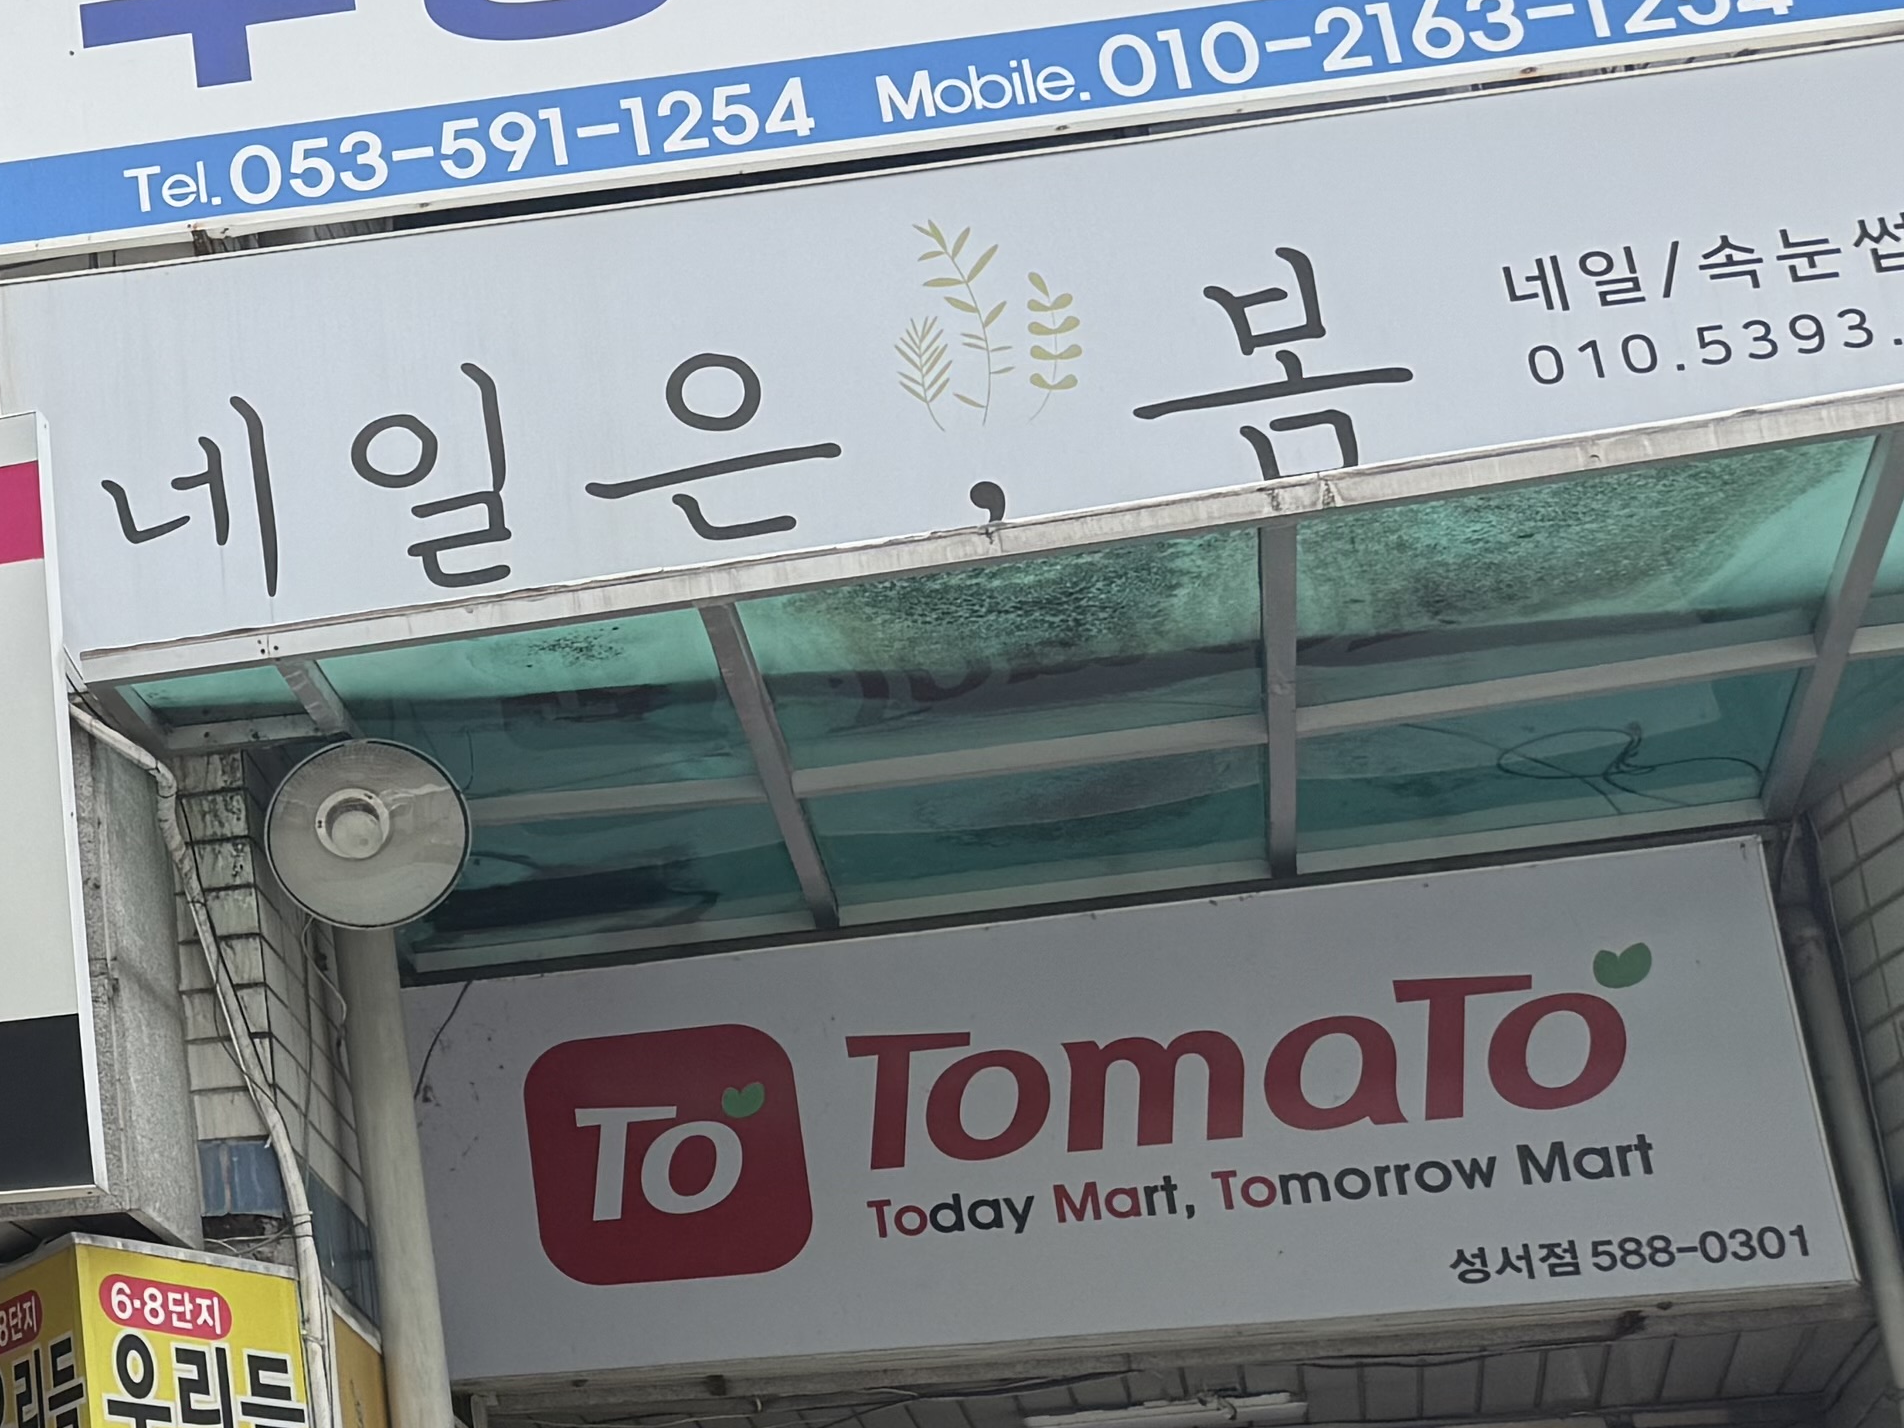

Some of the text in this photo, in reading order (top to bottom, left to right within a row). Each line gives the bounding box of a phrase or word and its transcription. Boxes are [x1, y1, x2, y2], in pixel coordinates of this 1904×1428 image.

[1132, 247, 1414, 483] 봄
[867, 1132, 1655, 1243] Today Mart, Tomorrow Mart
[1449, 1225, 1812, 1288] 성서점 588-0301
[106, 1278, 228, 1337] 6·8단지
